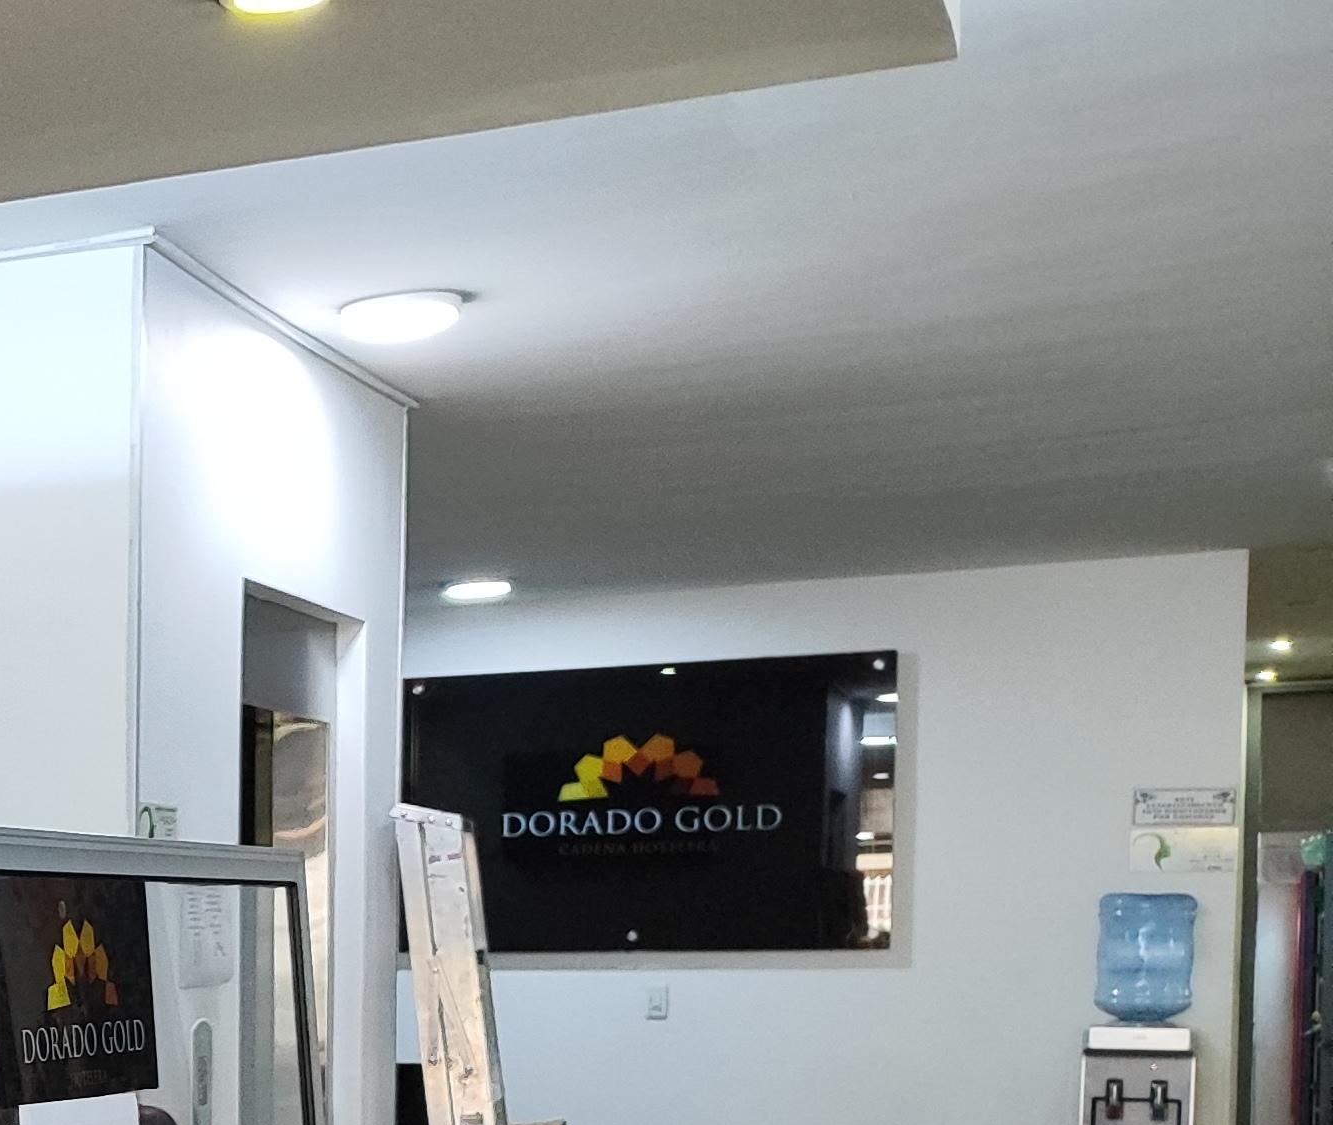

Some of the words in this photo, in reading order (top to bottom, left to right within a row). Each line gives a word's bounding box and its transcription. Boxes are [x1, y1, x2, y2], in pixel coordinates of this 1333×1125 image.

[502, 807, 663, 838] DORADO
[674, 803, 783, 834] GOLD
[21, 1023, 97, 1064] DORADO
[101, 1019, 146, 1055] GOLD
